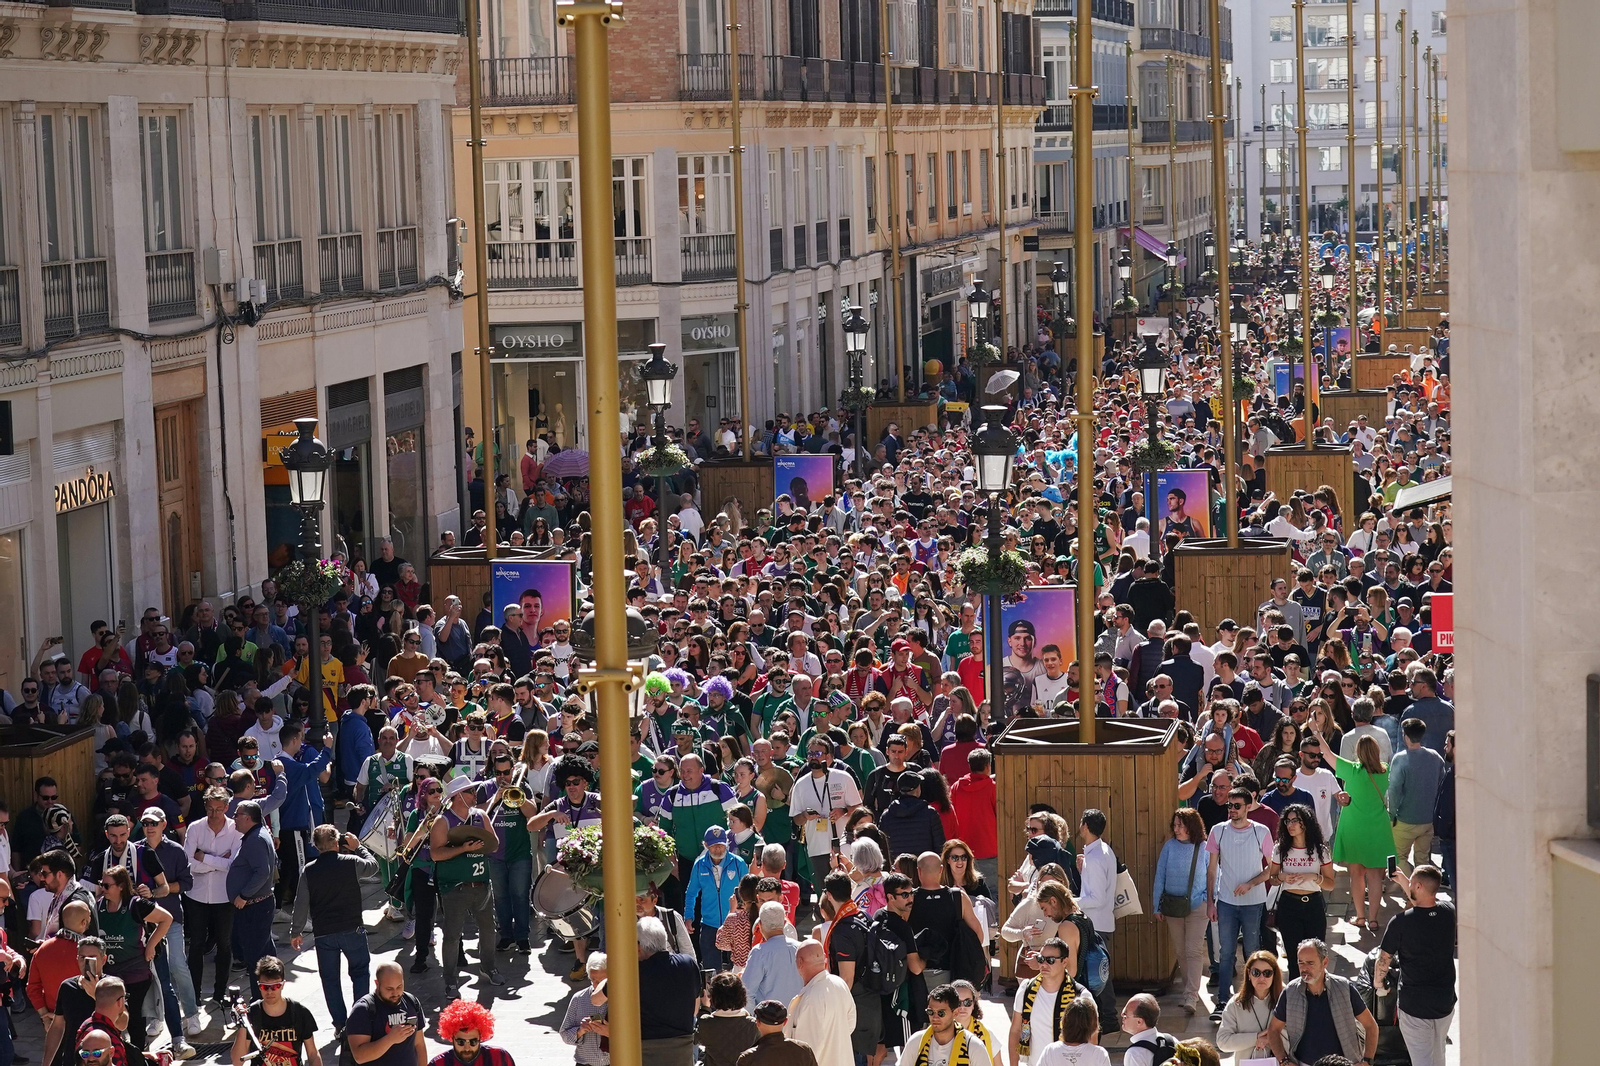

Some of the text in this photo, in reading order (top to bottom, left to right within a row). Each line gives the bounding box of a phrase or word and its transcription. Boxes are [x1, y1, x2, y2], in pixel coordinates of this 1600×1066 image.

[691, 325, 731, 340] OYSHO
[502, 334, 564, 349] OYSHO
[54, 471, 116, 511] PANDORA
[472, 861, 485, 876] 25
[104, 934, 125, 942] Unicaja
[388, 1012, 407, 1026] NIKE
